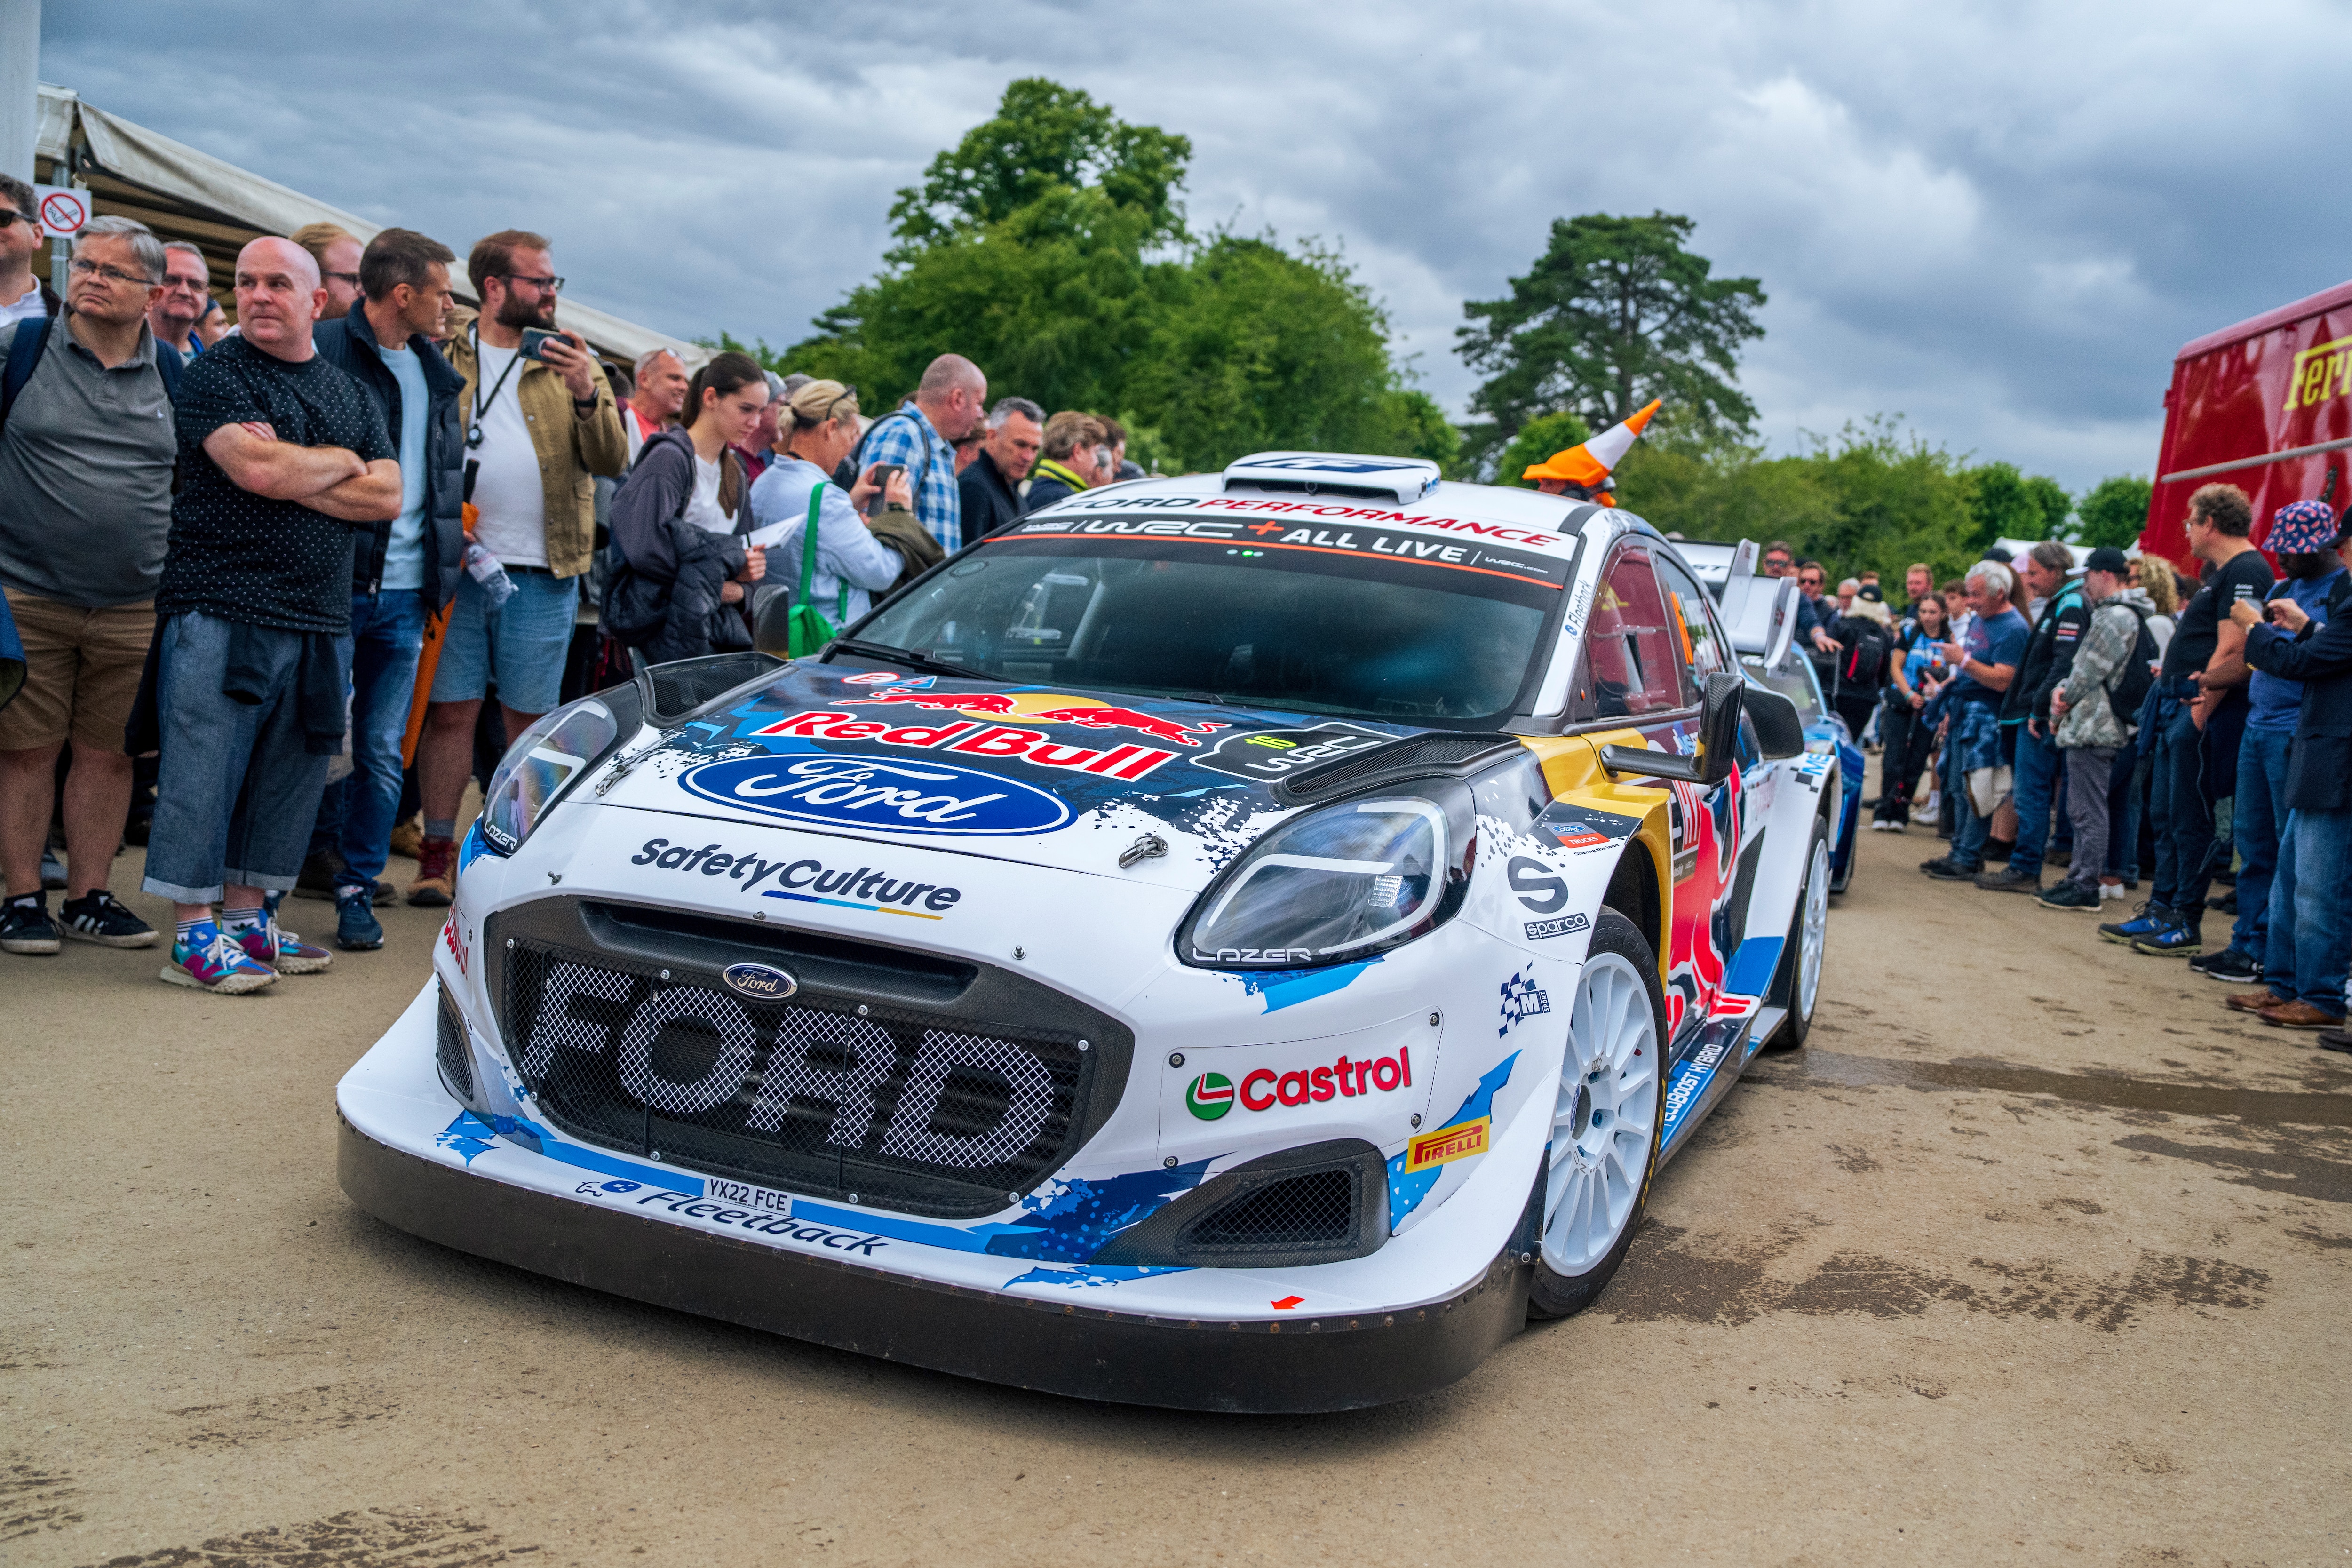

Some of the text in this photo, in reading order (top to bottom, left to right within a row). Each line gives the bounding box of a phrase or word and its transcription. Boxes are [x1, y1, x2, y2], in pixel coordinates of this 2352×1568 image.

[1279, 528, 1358, 549] ALL
[1372, 536, 1468, 562] LIVE
[751, 710, 1182, 781] Red Bull
[1244, 735, 1297, 750] 16
[1244, 736, 1382, 772] WRC
[734, 759, 1009, 823] Ford
[1568, 836, 1599, 845] TRUCKS
[631, 838, 961, 911] SafetyCulture
[1527, 915, 1586, 939] sparco
[1192, 947, 1311, 962] LAZER
[737, 969, 778, 992] Ford
[1541, 991, 1549, 1011] SPORT
[519, 962, 1054, 1168] FORD
[1687, 1043, 1724, 1074] HYBRID
[1240, 1046, 1411, 1111] Castrol
[1413, 1125, 1483, 1165] PIRELLI
[1589, 1152, 1606, 1173] RACING
[710, 1179, 787, 1211] YX22 FCE
[636, 1191, 890, 1256] Fleetback
